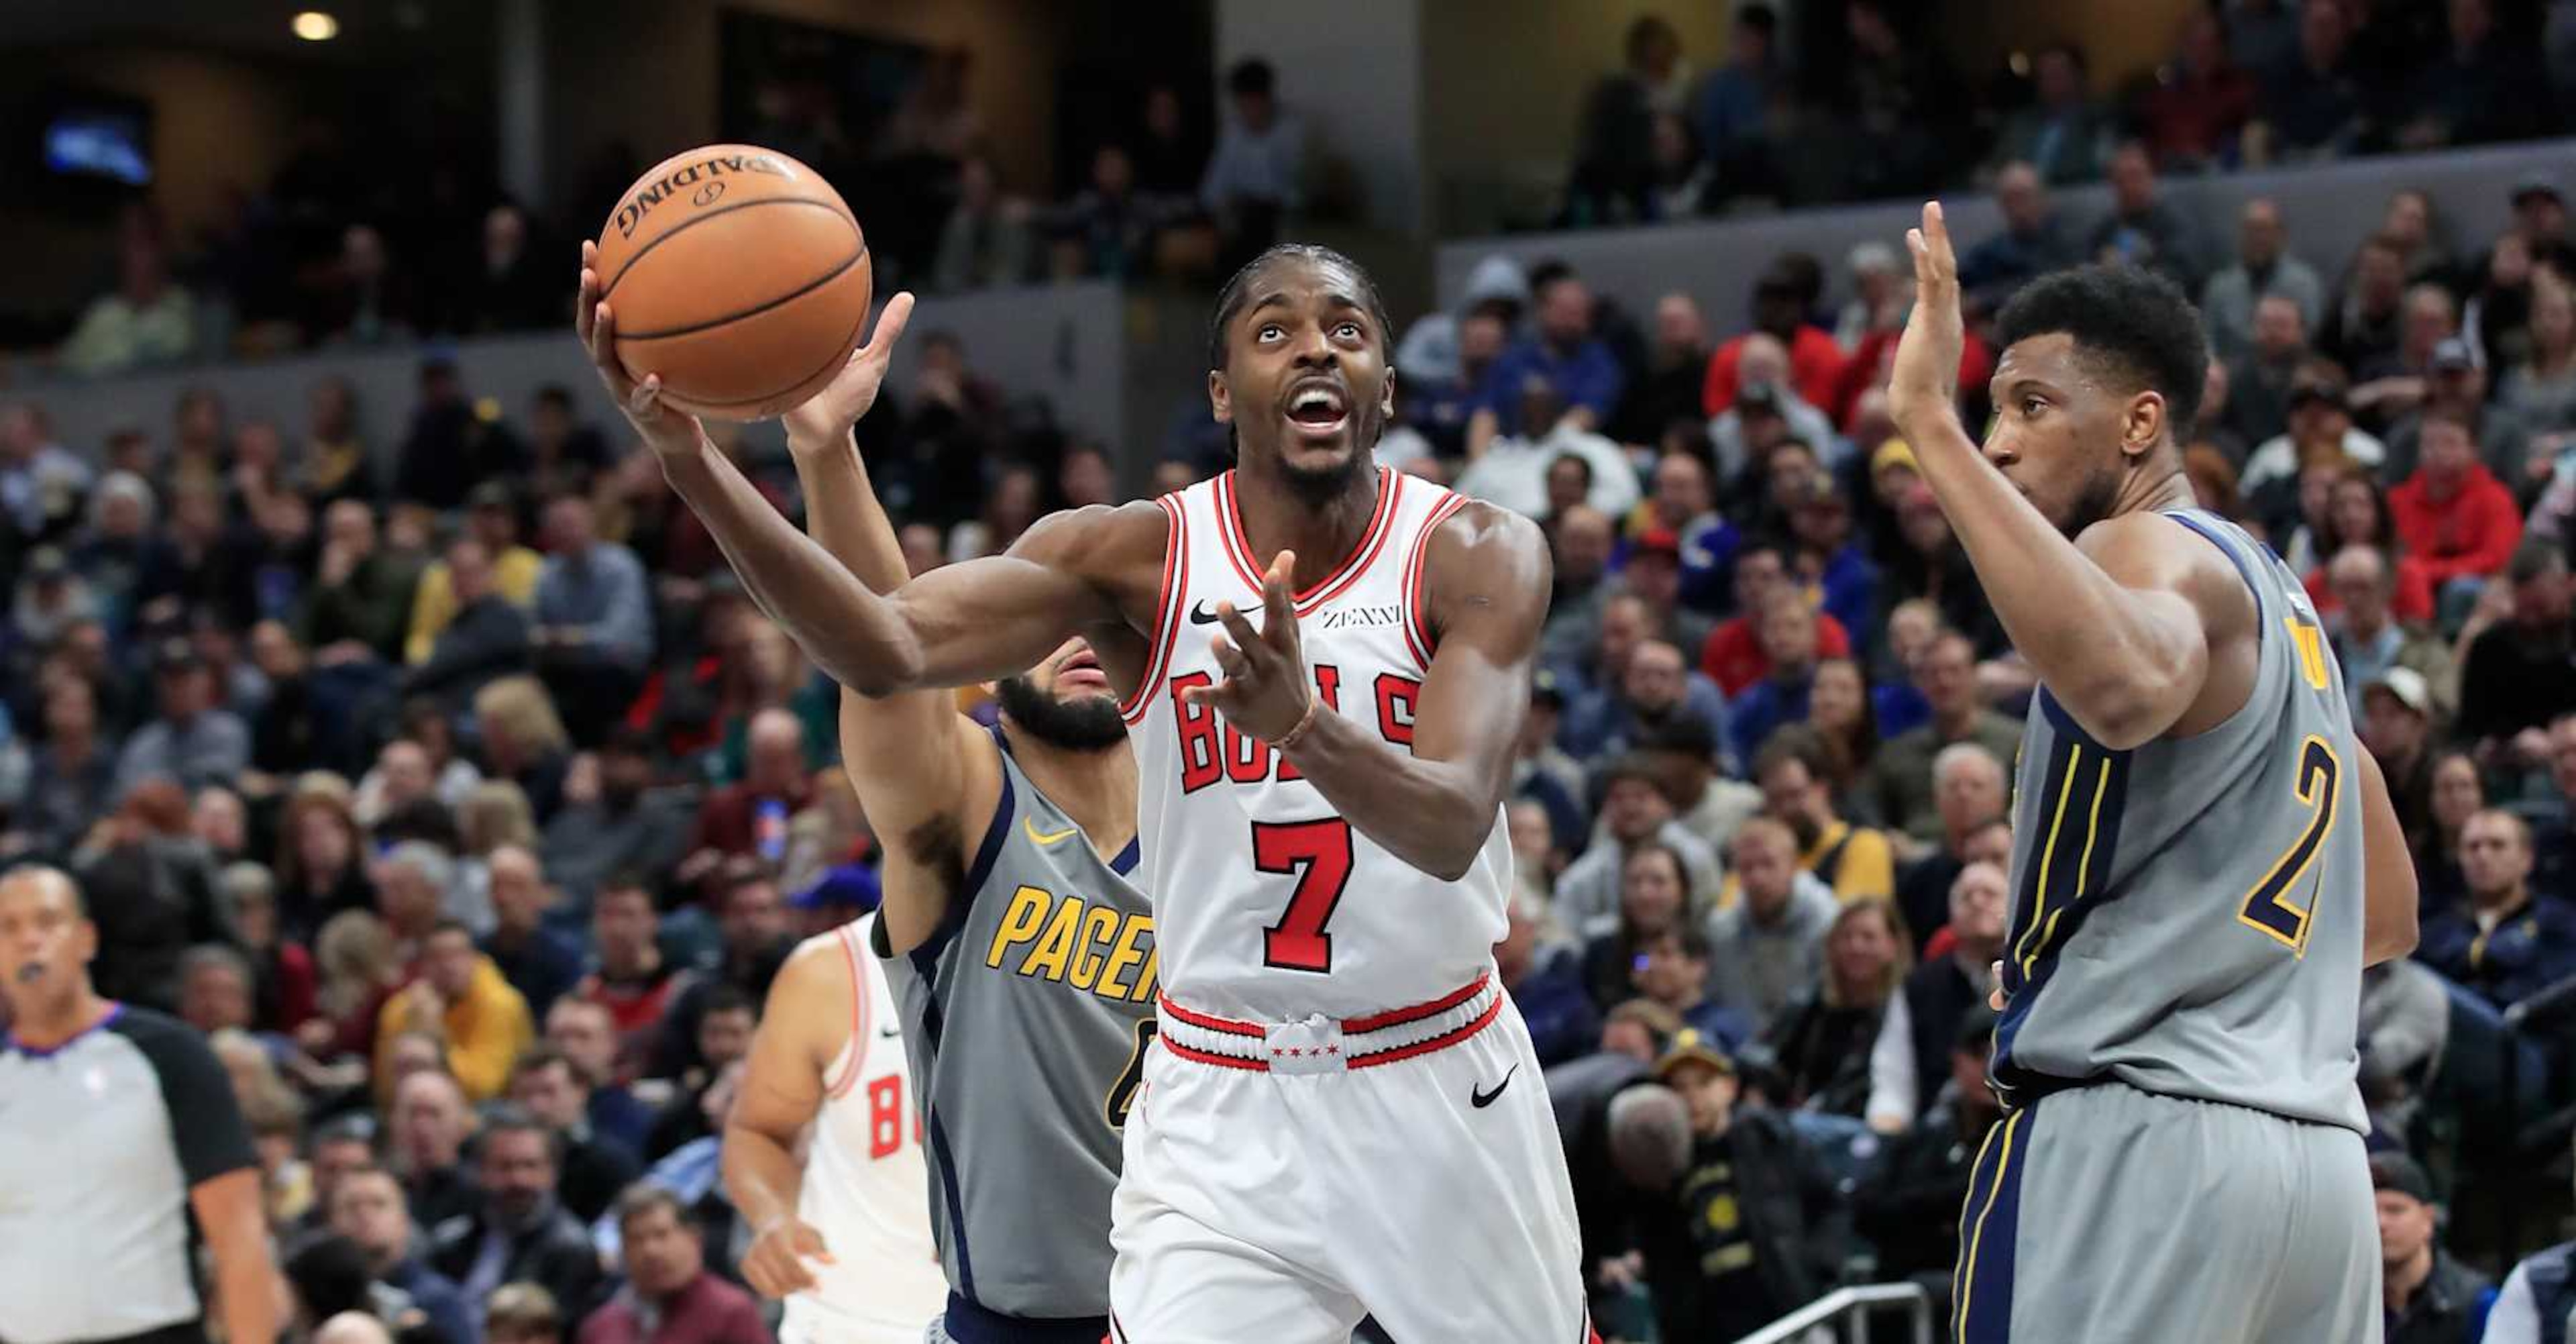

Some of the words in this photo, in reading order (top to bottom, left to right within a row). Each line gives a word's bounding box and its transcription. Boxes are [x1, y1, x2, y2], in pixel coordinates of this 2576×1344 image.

[616, 155, 784, 239] PALDING
[1324, 605, 1400, 629] ZENNI
[1171, 664, 1421, 794] BUS
[1250, 816, 1354, 975] 7
[2237, 733, 2341, 959] 2
